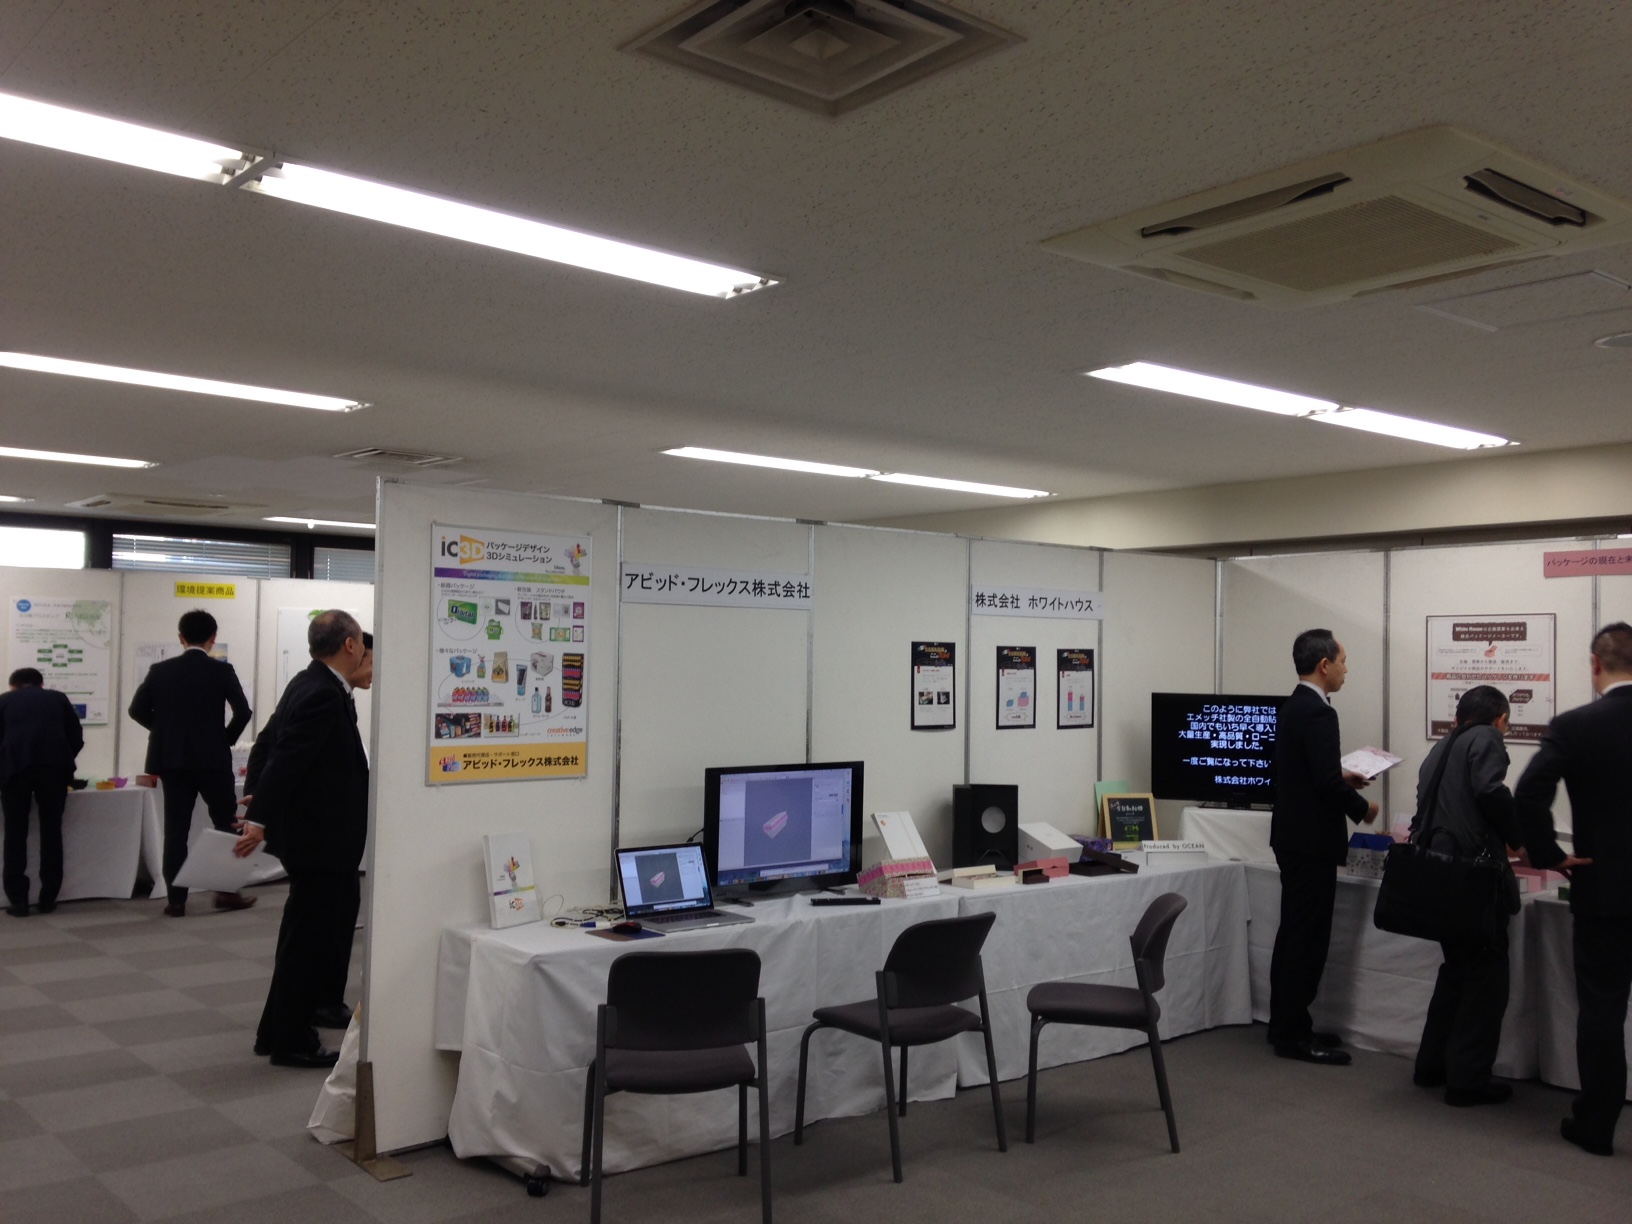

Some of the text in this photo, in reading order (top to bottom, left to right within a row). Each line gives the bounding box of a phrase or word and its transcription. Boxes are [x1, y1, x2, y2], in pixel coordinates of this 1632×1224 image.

[486, 541, 550, 554] パッケージデザイン
[486, 551, 552, 564] 3Dシミュレーション
[1547, 555, 1632, 567] パッケージの現在と未
[176, 584, 235, 596] 環境提案商品
[625, 572, 811, 599] アビッド・フレックス株式会社
[975, 592, 1093, 612] 株式会社 ホワイトハウス
[1203, 705, 1277, 714] このように弊社では
[1187, 713, 1277, 723] エメッチ社製の全自動貼
[1210, 740, 1263, 750] 実現しました。
[463, 756, 579, 770] アビッド・フレックス株式会社
